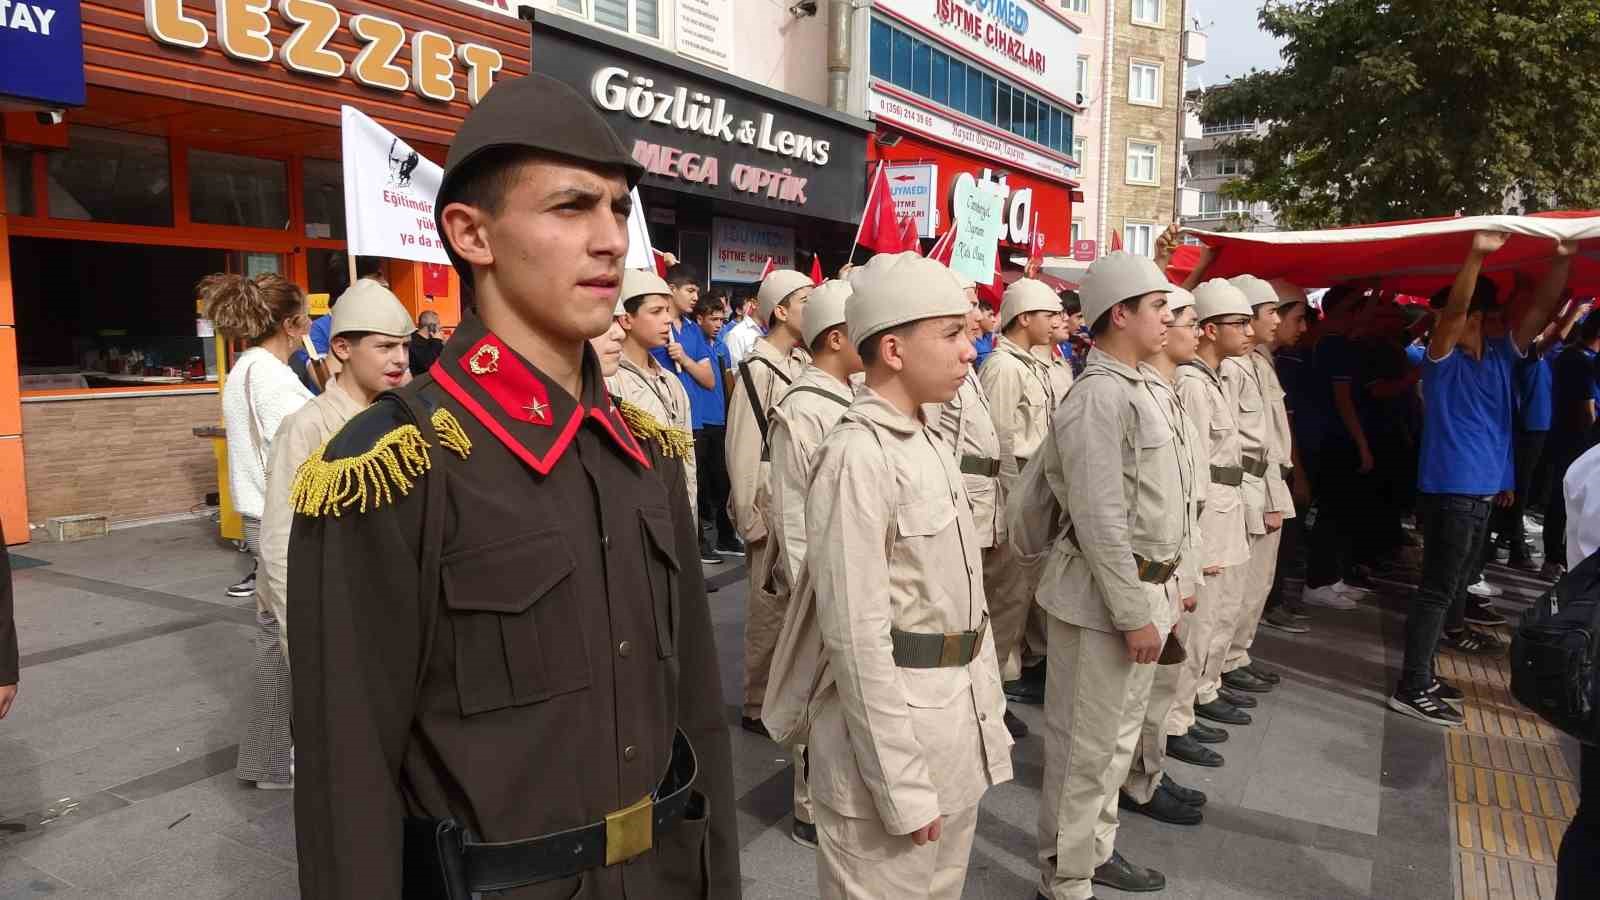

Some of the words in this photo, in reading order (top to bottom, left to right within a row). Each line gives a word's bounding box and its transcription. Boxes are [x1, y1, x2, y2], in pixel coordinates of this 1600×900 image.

[0, 0, 56, 36] TAY
[145, 0, 502, 105] LEZZET
[985, 23, 1046, 74] CİHAZLARI
[592, 66, 735, 142] Gözlük
[736, 119, 757, 145] &
[757, 112, 830, 166] Lens
[632, 139, 719, 186] MEGA
[731, 163, 808, 205] OPTİK
[383, 190, 432, 213] Eğitimdir
[400, 233, 415, 246] ya
[418, 234, 432, 247] da
[416, 216, 436, 231] yük
